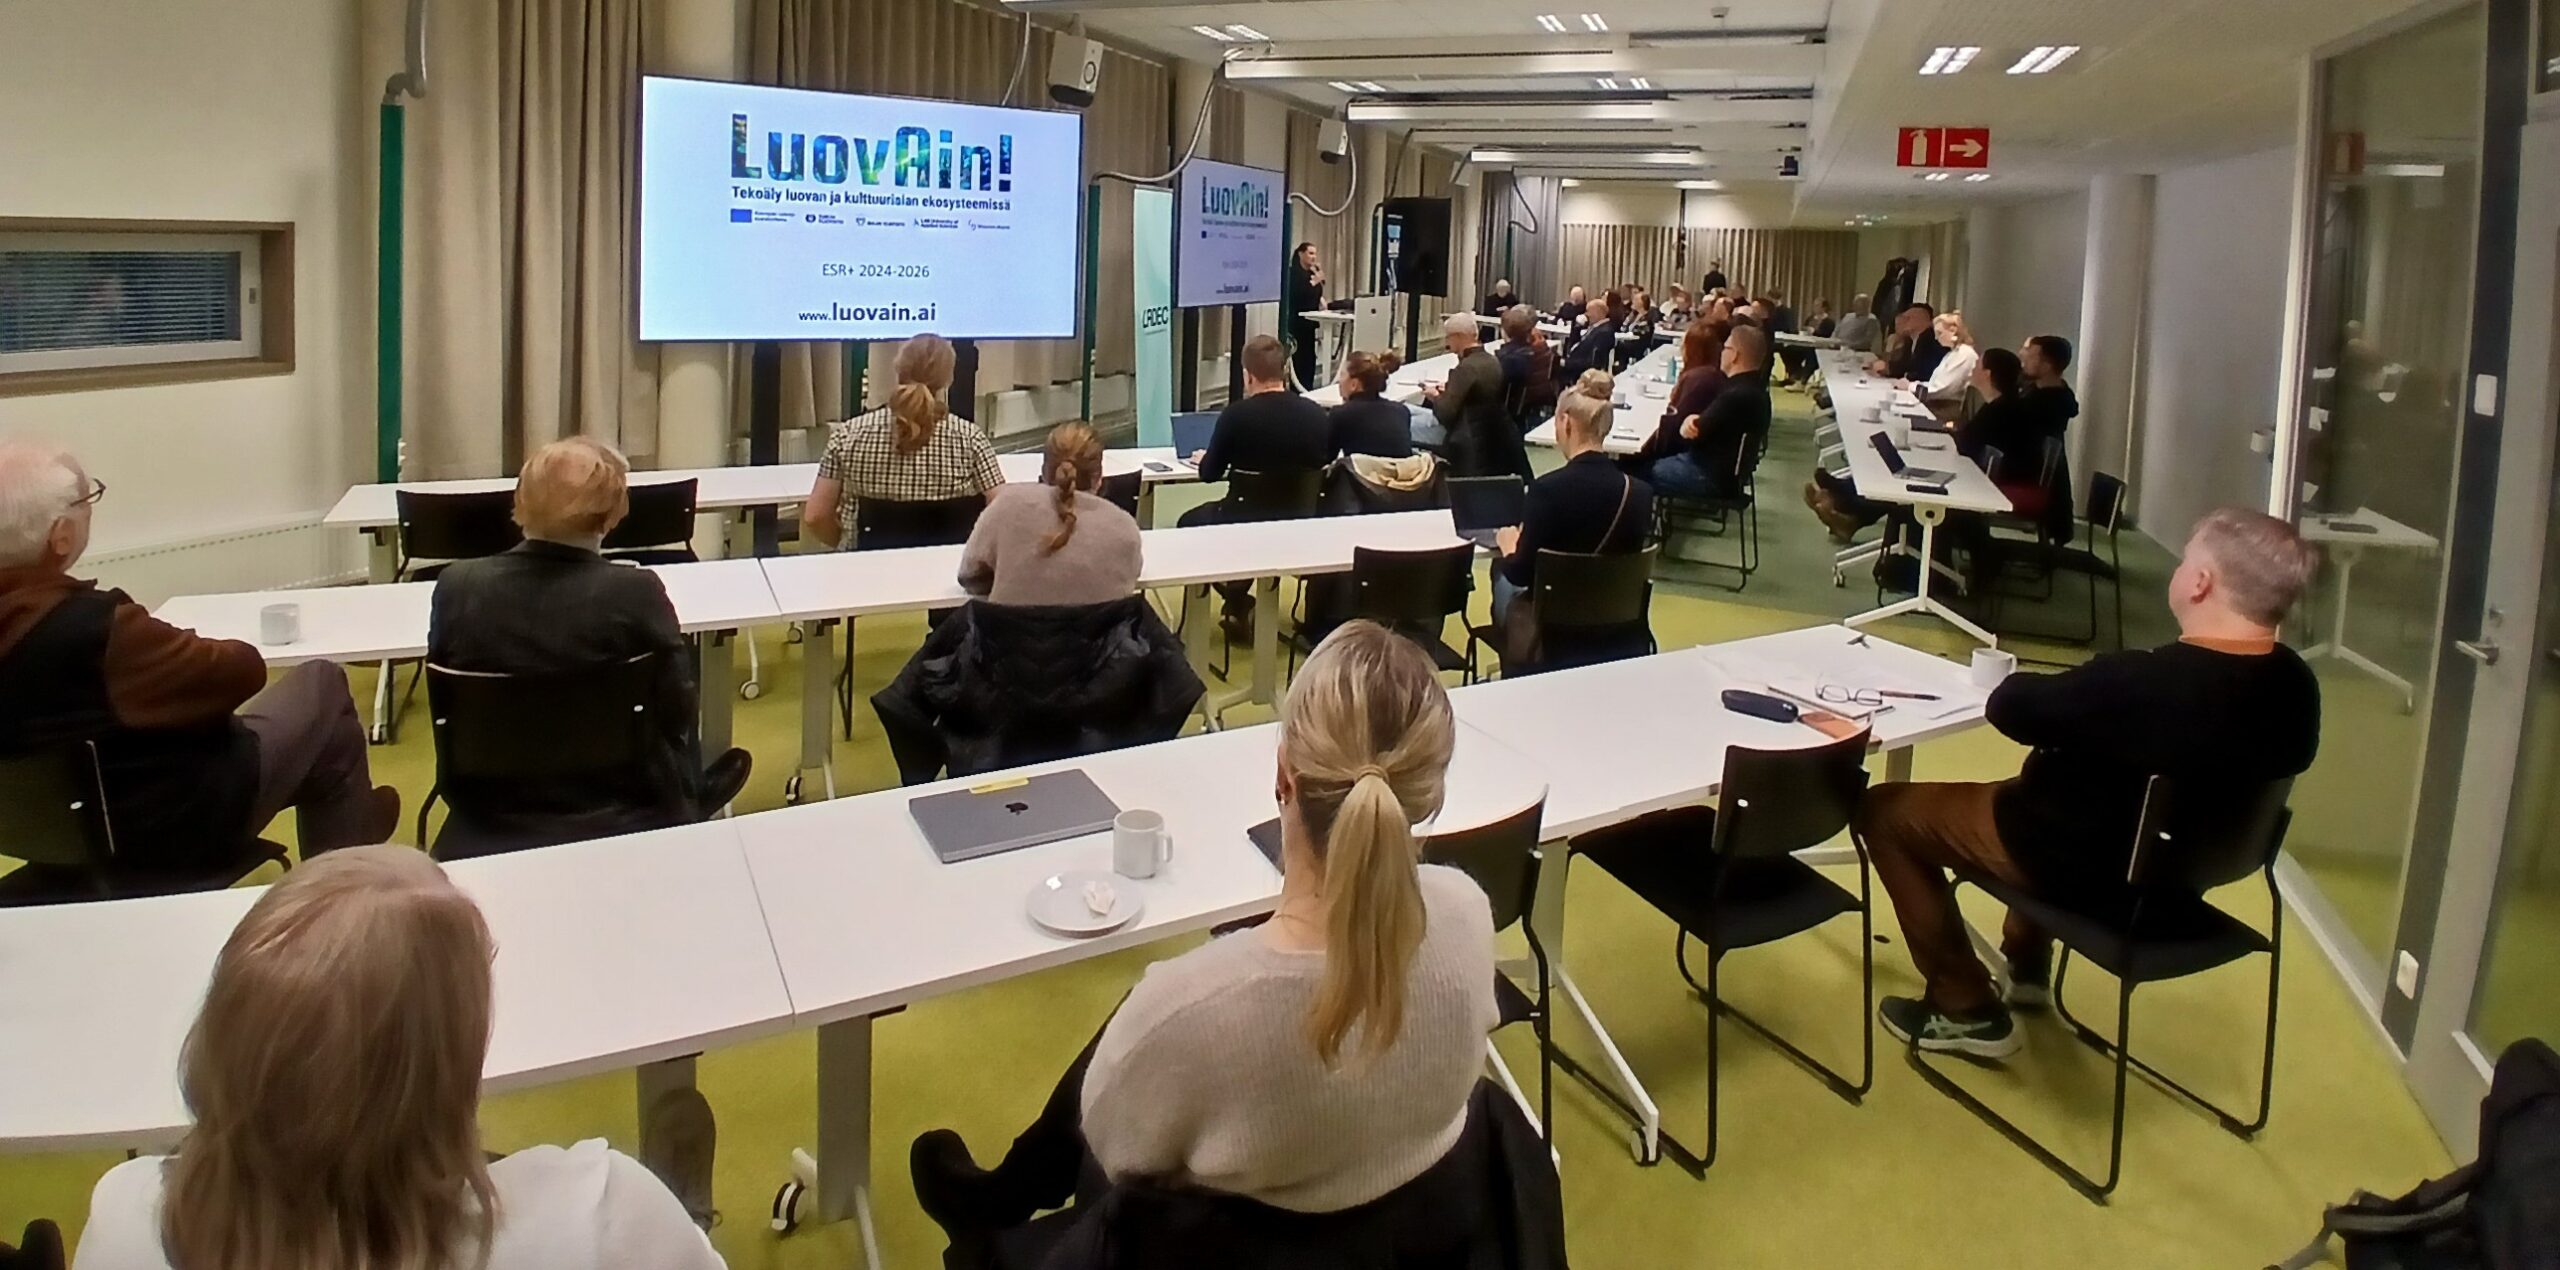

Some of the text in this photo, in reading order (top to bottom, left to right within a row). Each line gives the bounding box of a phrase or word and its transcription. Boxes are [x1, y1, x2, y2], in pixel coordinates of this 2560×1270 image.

[731, 113, 1012, 192] LuovAin!
[732, 186, 1011, 211] Tekoäly luovan ja kulttuurialan ekosysteemissä
[1202, 176, 1269, 218] LuovAin!
[822, 263, 930, 278] ESR+ 2024-2026
[798, 302, 936, 321] www.luovain.ai
